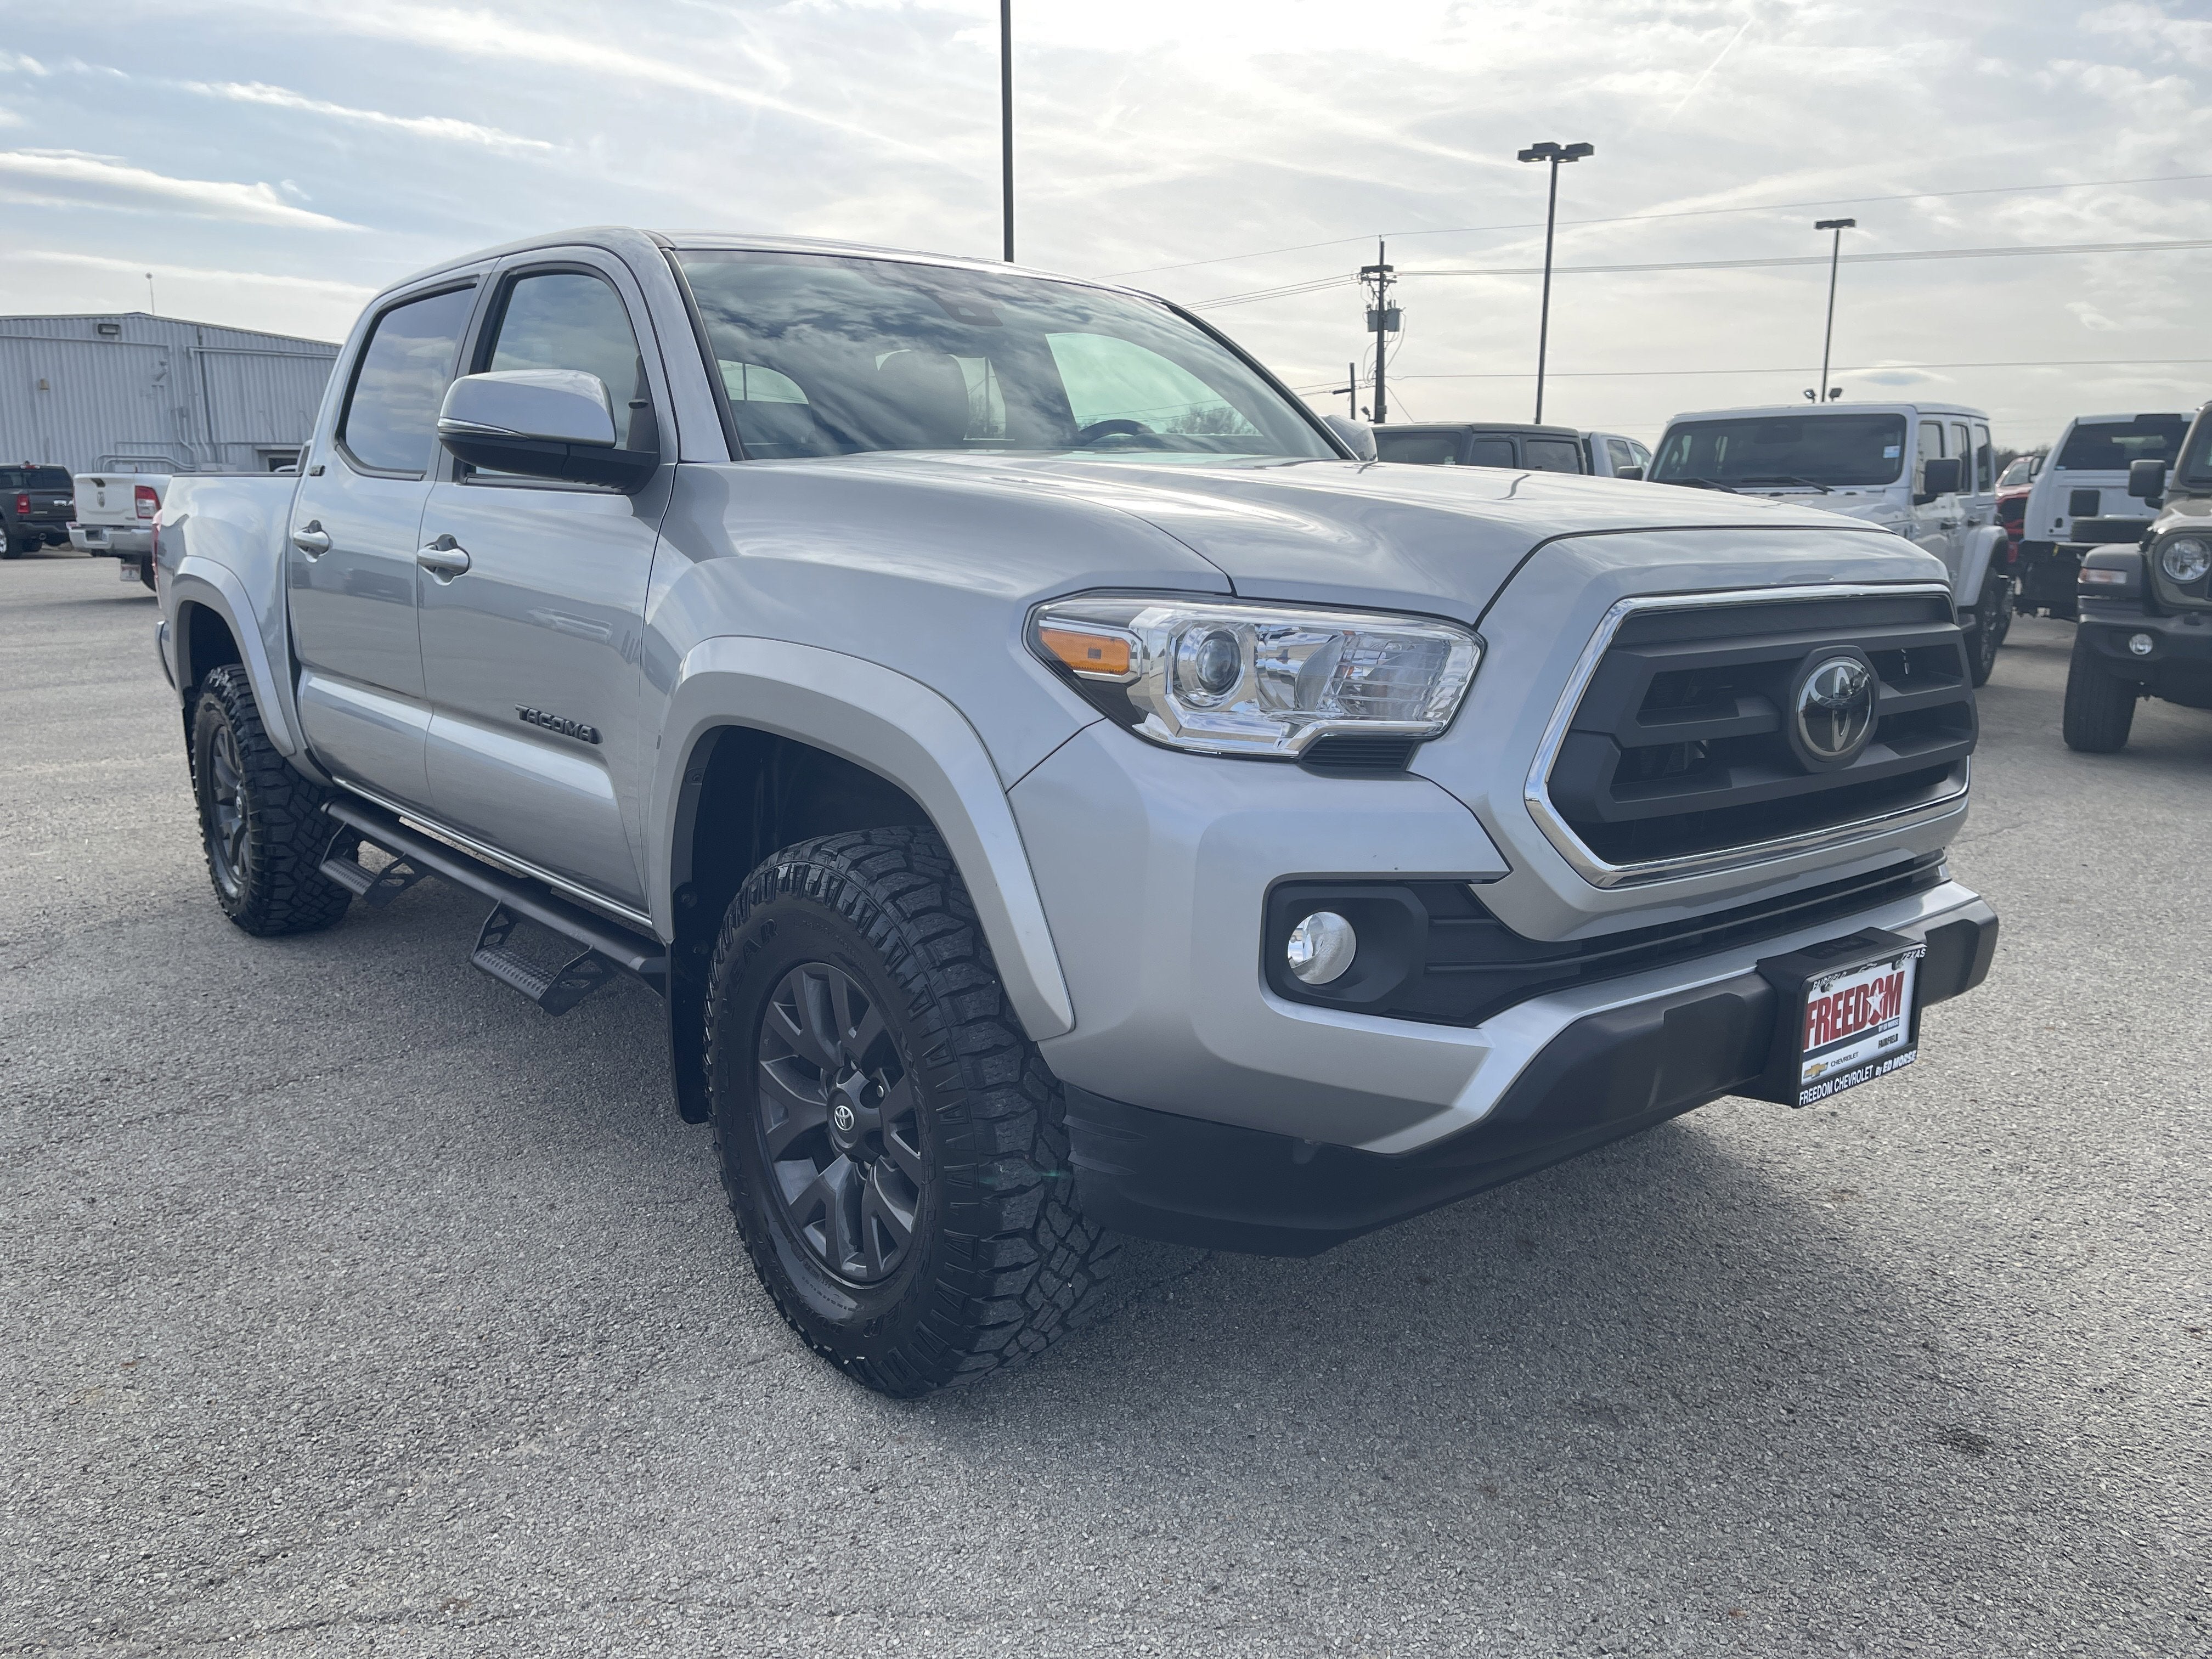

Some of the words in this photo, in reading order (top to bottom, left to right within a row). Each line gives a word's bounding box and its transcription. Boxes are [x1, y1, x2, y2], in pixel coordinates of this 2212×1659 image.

[515, 704, 600, 744] TACOMA
[1901, 948, 1927, 961] TEXAS
[1803, 971, 1905, 1051] FREEDOM
[1878, 1033, 1899, 1049] FAIRFIELD
[1830, 1051, 1859, 1068] CHEVROLET
[1799, 1080, 1833, 1106] FREEDOM
[1833, 1065, 1874, 1092] CHEVROLET
[1882, 1059, 1892, 1073] ED
[1892, 1050, 1917, 1068] MORSE
